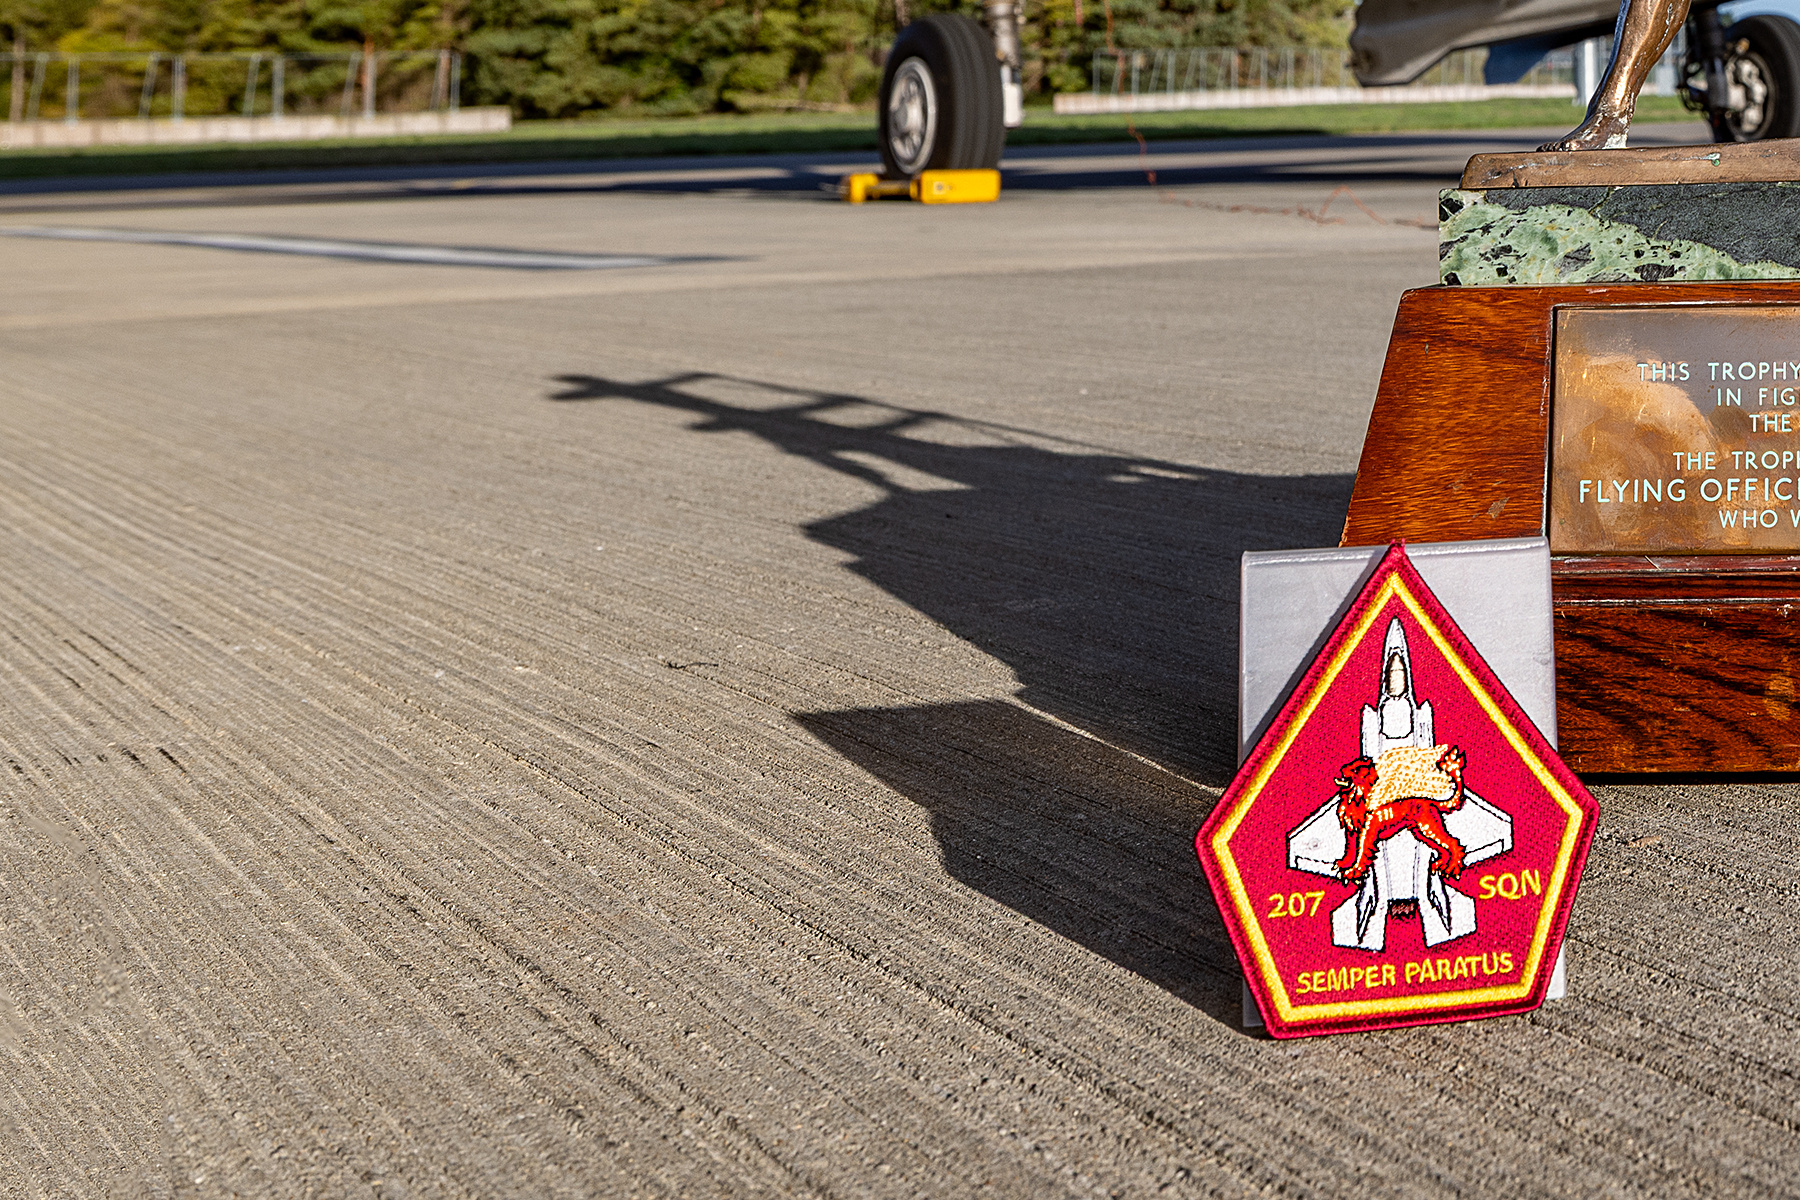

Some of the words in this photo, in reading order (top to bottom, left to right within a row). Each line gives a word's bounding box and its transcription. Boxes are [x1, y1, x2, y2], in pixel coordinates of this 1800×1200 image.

[1637, 363, 1690, 382] THIS
[1708, 361, 1800, 381] TROPHY
[1717, 388, 1741, 406] IN
[1749, 414, 1792, 432] THE
[1673, 452, 1716, 470] THE
[1580, 479, 1685, 503] FLYING
[1719, 510, 1778, 528] WHO
[1268, 890, 1326, 919] 207
[1479, 868, 1542, 900] SQN
[1296, 963, 1397, 994] SEMPER
[1405, 950, 1515, 984] PARATUS
